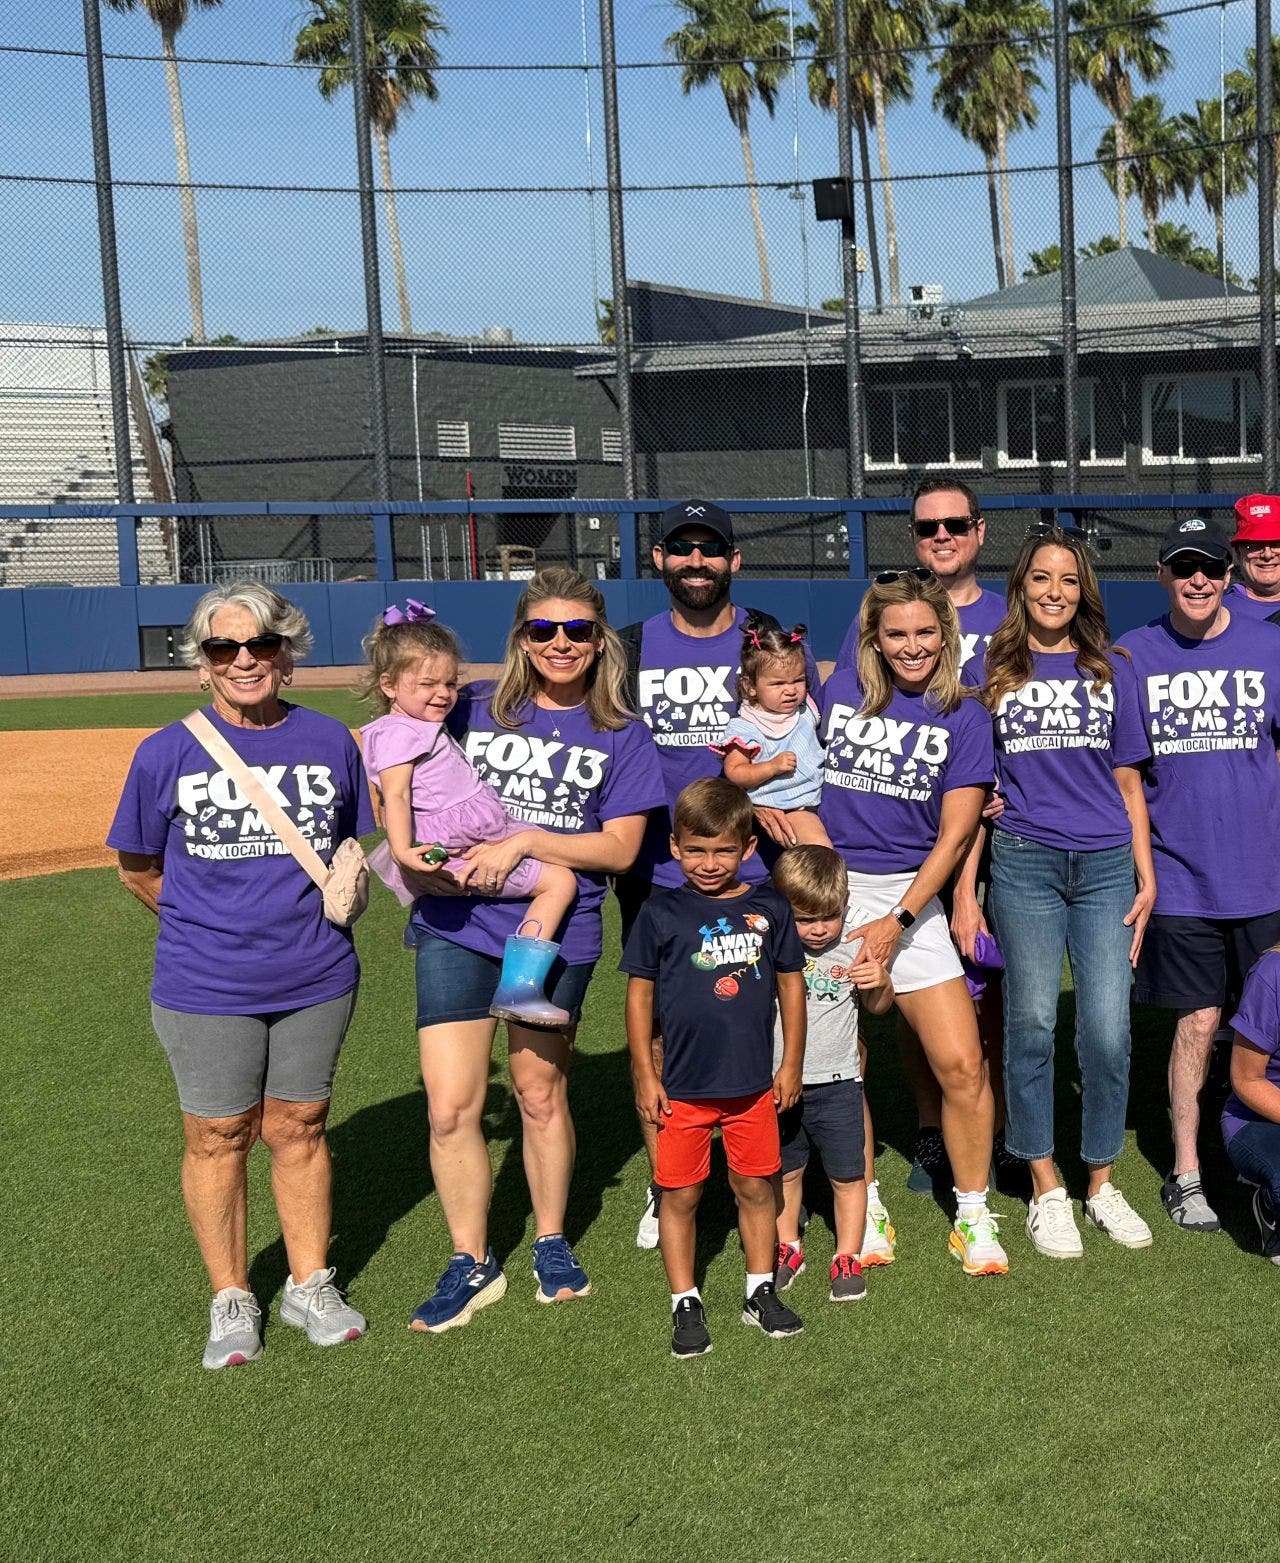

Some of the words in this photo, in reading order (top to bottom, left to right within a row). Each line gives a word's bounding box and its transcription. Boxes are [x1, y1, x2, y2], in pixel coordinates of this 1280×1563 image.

[503, 466, 578, 485] WOMEN
[639, 666, 734, 708] FOX
[1147, 670, 1231, 713] FOX
[1232, 670, 1265, 708] 13
[679, 733, 708, 745] LOCAL
[825, 703, 915, 755] FOX
[912, 724, 950, 764] 13
[1004, 735, 1030, 754] FOX
[1030, 736, 1060, 750] LOCAL
[1153, 740, 1181, 756] FOX
[1182, 738, 1210, 752] LOCAL
[1211, 737, 1244, 750] TAMPA
[465, 731, 565, 779] FOX
[562, 745, 609, 789] 13
[292, 764, 336, 805] 13
[825, 769, 841, 786] OX
[840, 773, 871, 791] LOCAL
[872, 780, 909, 800] TAMPA
[910, 787, 932, 801] BAY
[522, 809, 563, 828] TAMPA
[186, 842, 224, 860] FOX
[224, 843, 263, 857] LOCAL
[701, 932, 763, 952] ALWAYS
[712, 947, 757, 966] GAME
[803, 976, 841, 993] das
